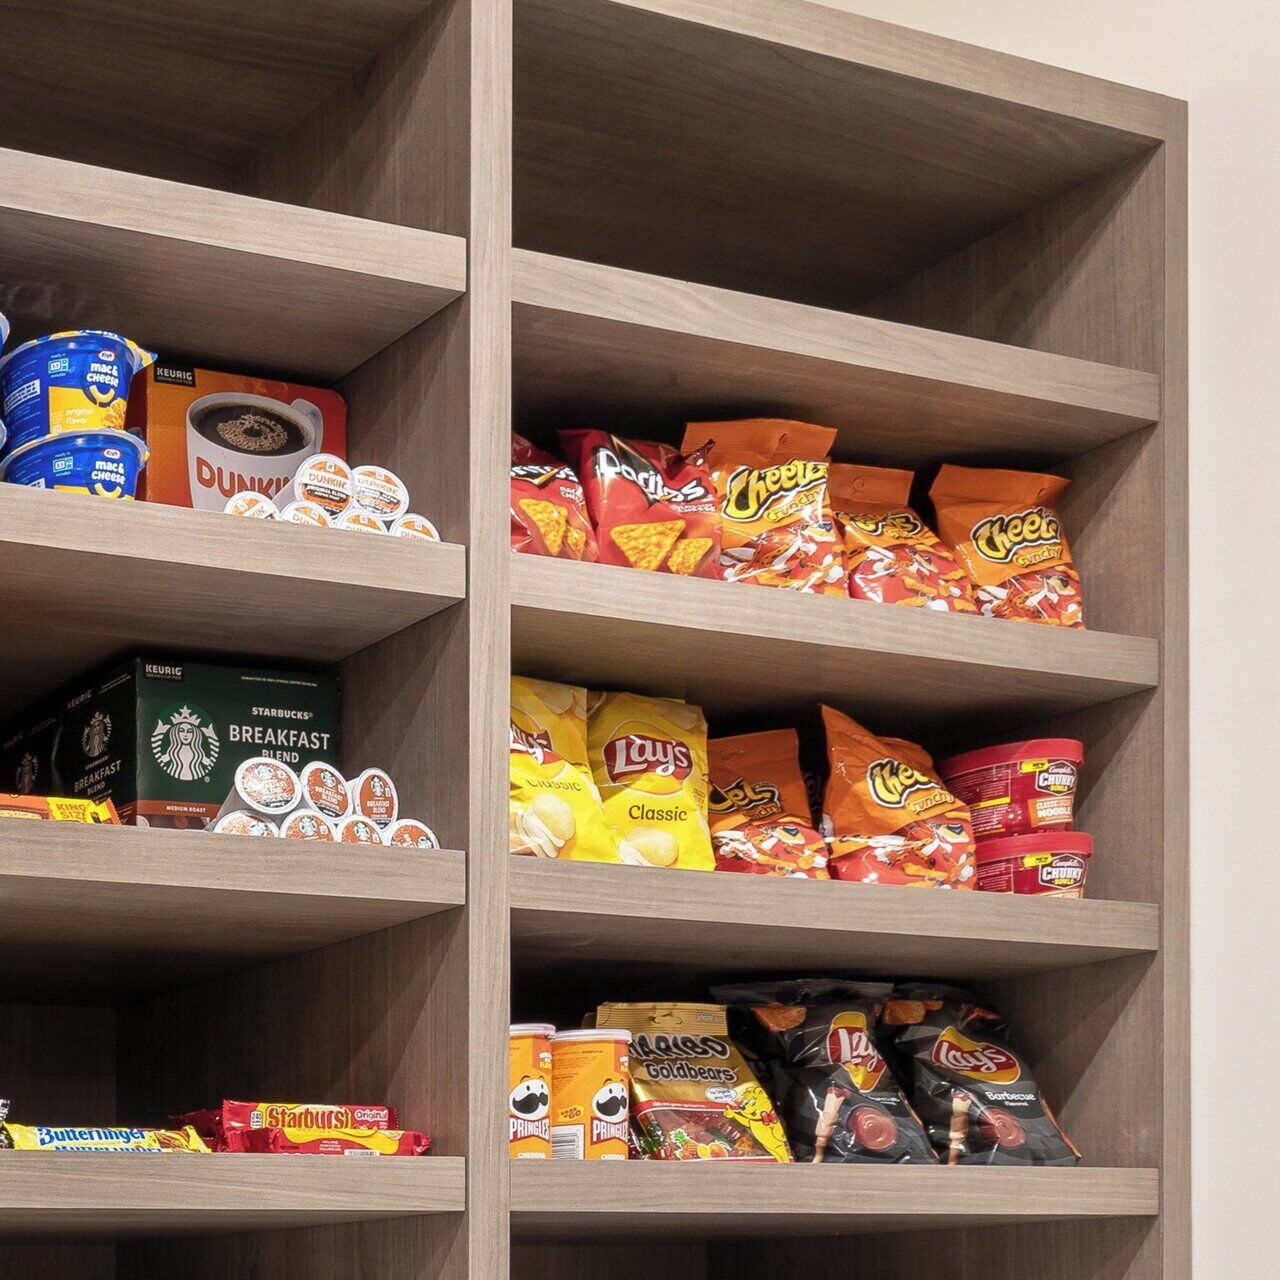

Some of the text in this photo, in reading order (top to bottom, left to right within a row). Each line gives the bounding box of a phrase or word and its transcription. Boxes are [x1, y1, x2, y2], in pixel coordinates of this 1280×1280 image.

[156, 367, 193, 380] KEURIG
[596, 448, 708, 502] Doritos
[145, 664, 182, 675] KEURIG
[252, 707, 309, 720] STARBUCKS
[230, 724, 330, 750] BREAKFAST
[262, 750, 300, 763] BLEND
[613, 735, 690, 776] Lay's
[74, 760, 122, 792] BREAKFAST
[1039, 773, 1074, 786] CHUNKY
[56, 803, 86, 811] KING
[629, 805, 688, 821] Classic
[1042, 867, 1082, 880] CHUNKY
[940, 1041, 1008, 1073] Lay's
[645, 1062, 737, 1082] Goldbears
[984, 1091, 1036, 1101] Barbecue
[267, 1107, 389, 1129] Starburst Original
